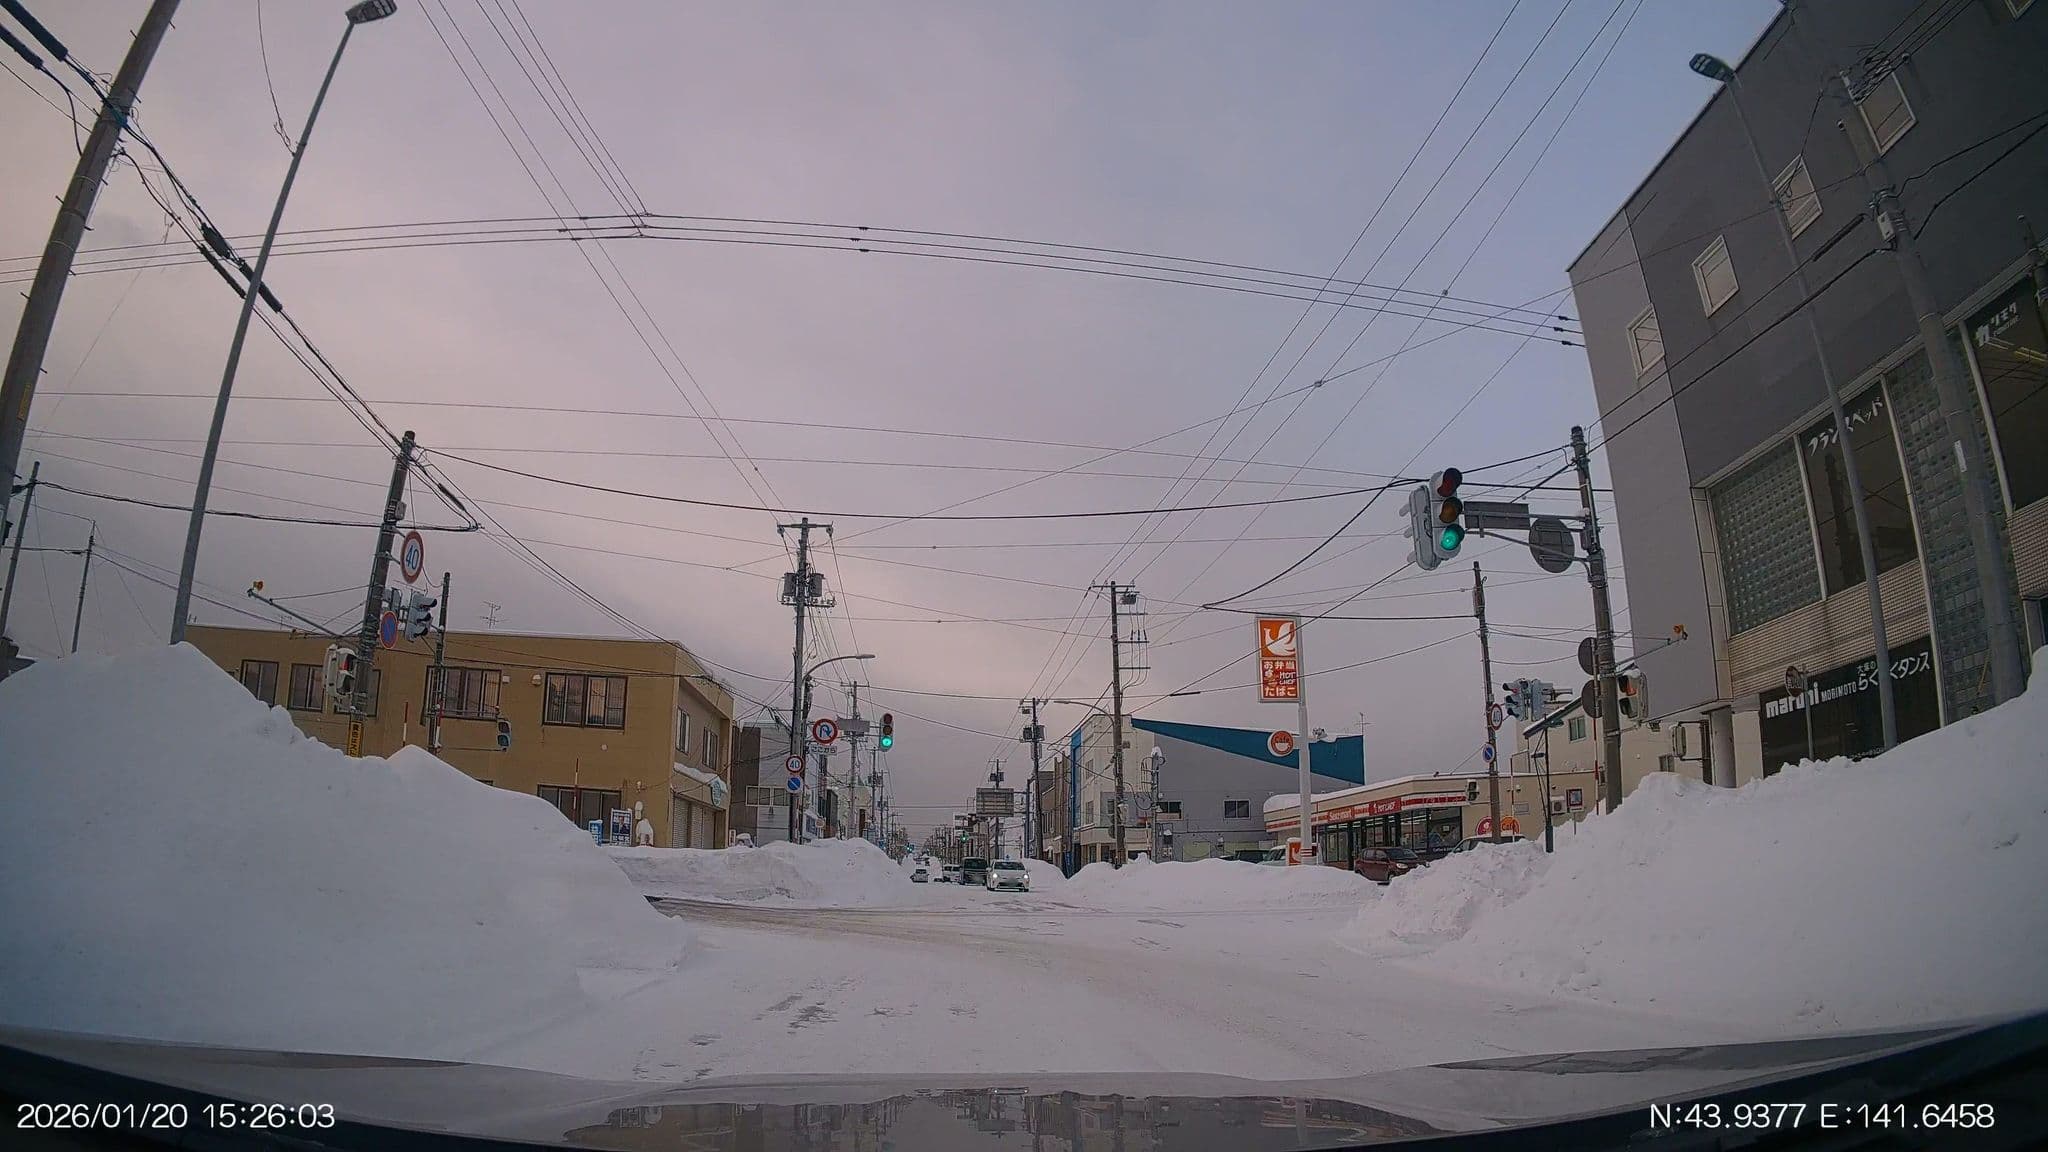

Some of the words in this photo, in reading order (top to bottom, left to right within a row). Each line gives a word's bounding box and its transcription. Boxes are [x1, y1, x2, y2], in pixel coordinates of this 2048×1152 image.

[406, 544, 419, 570] 40
[1263, 660, 1295, 670] お弁当
[1280, 671, 1296, 679] HOT
[1858, 651, 1930, 690] らくくタンス
[1264, 686, 1296, 696] たばこ
[1493, 710, 1501, 722] 40
[811, 745, 836, 754] ここから
[789, 760, 800, 769] 40
